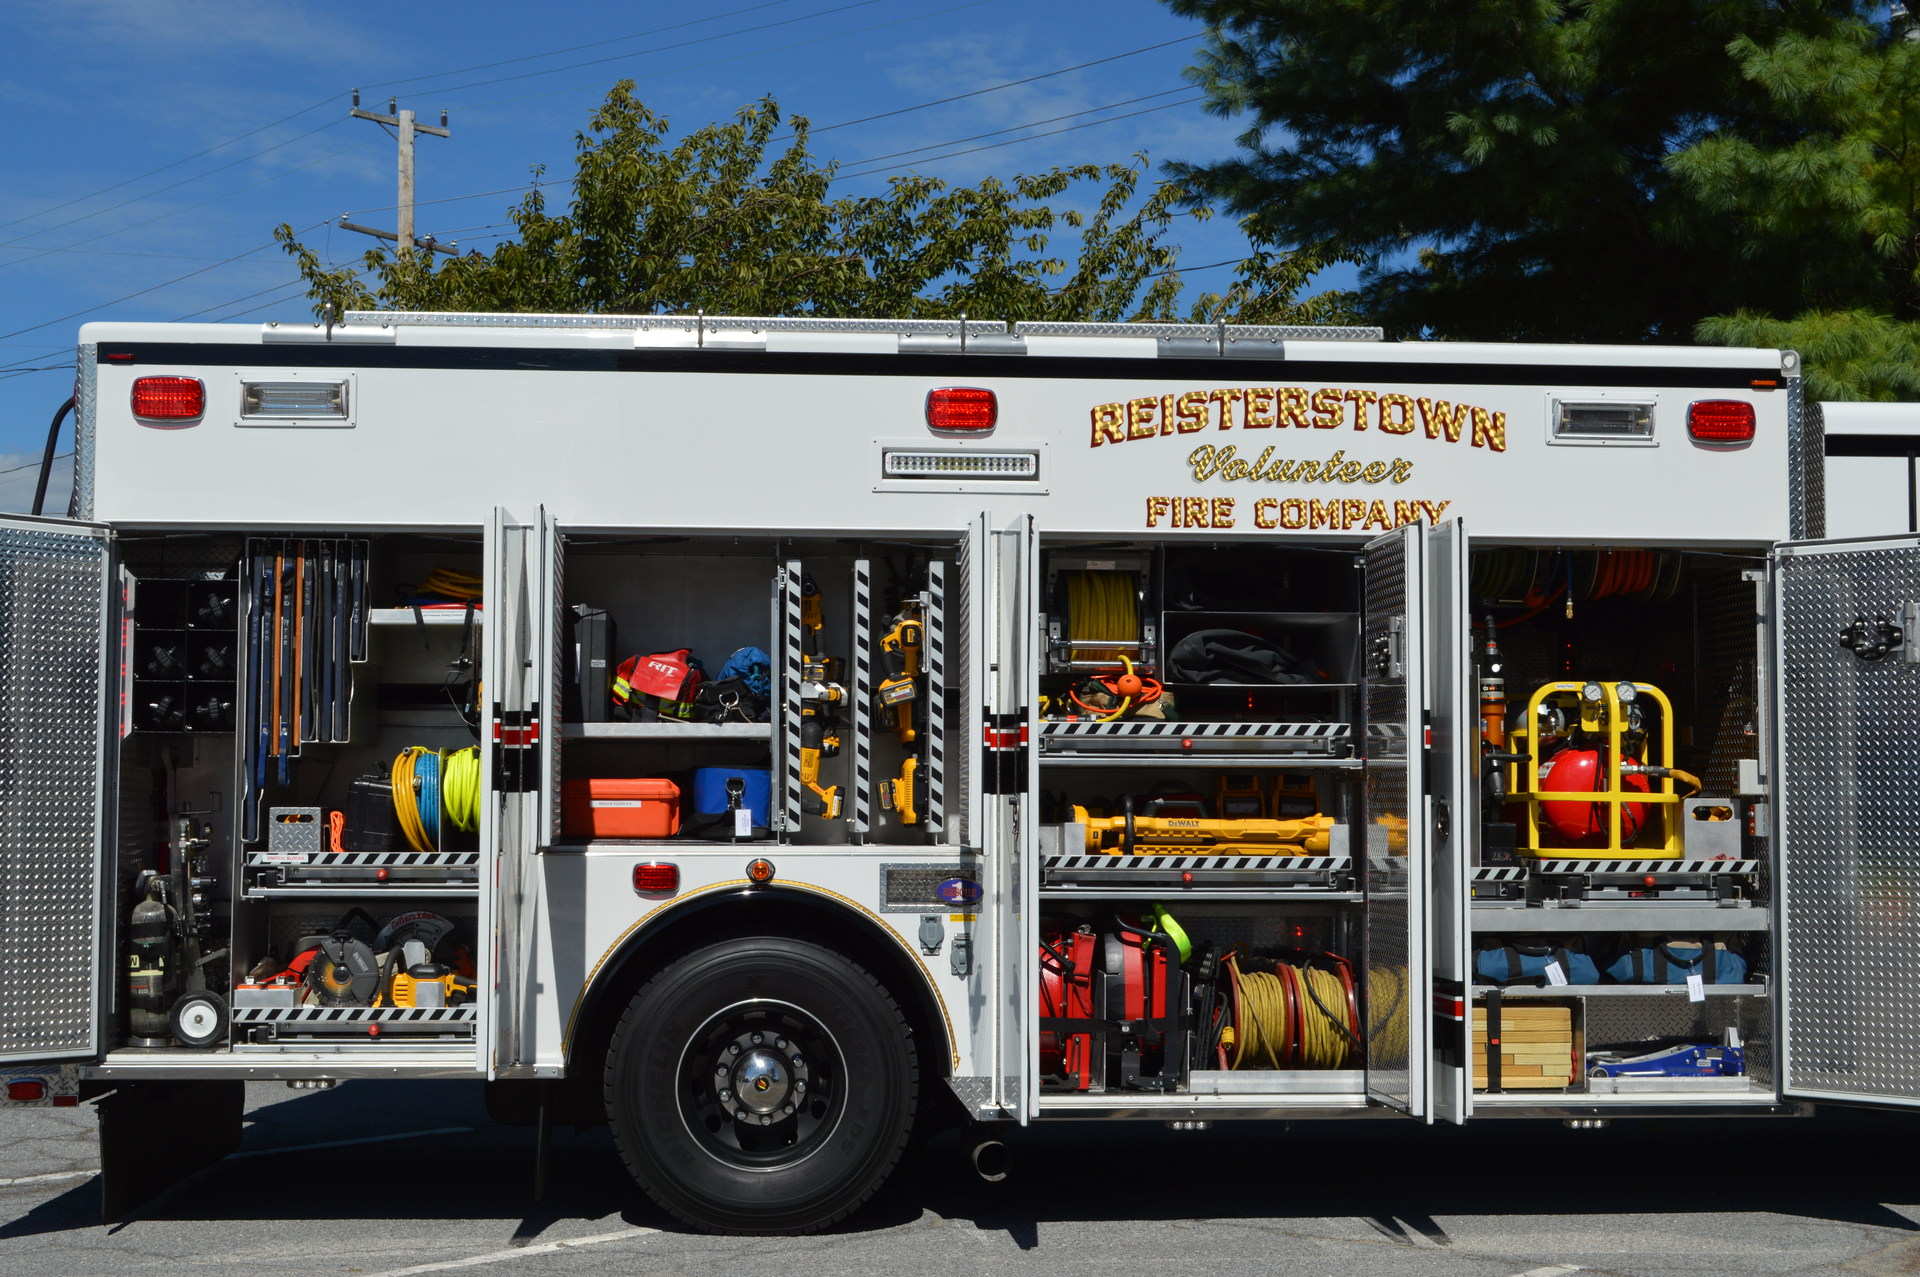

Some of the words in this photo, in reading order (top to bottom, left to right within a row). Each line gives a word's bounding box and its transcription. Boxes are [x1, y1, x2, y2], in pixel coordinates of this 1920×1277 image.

[1090, 387, 1507, 453] REISTERSTOWN
[1188, 444, 1414, 484] Volunteer
[1146, 496, 1236, 528] FIRE
[1254, 498, 1452, 531] COMPANY
[648, 660, 678, 676] RIT
[942, 887, 977, 897] RESCUE
[417, 912, 437, 920] Edge
[650, 1019, 698, 1168] MICHELIN
